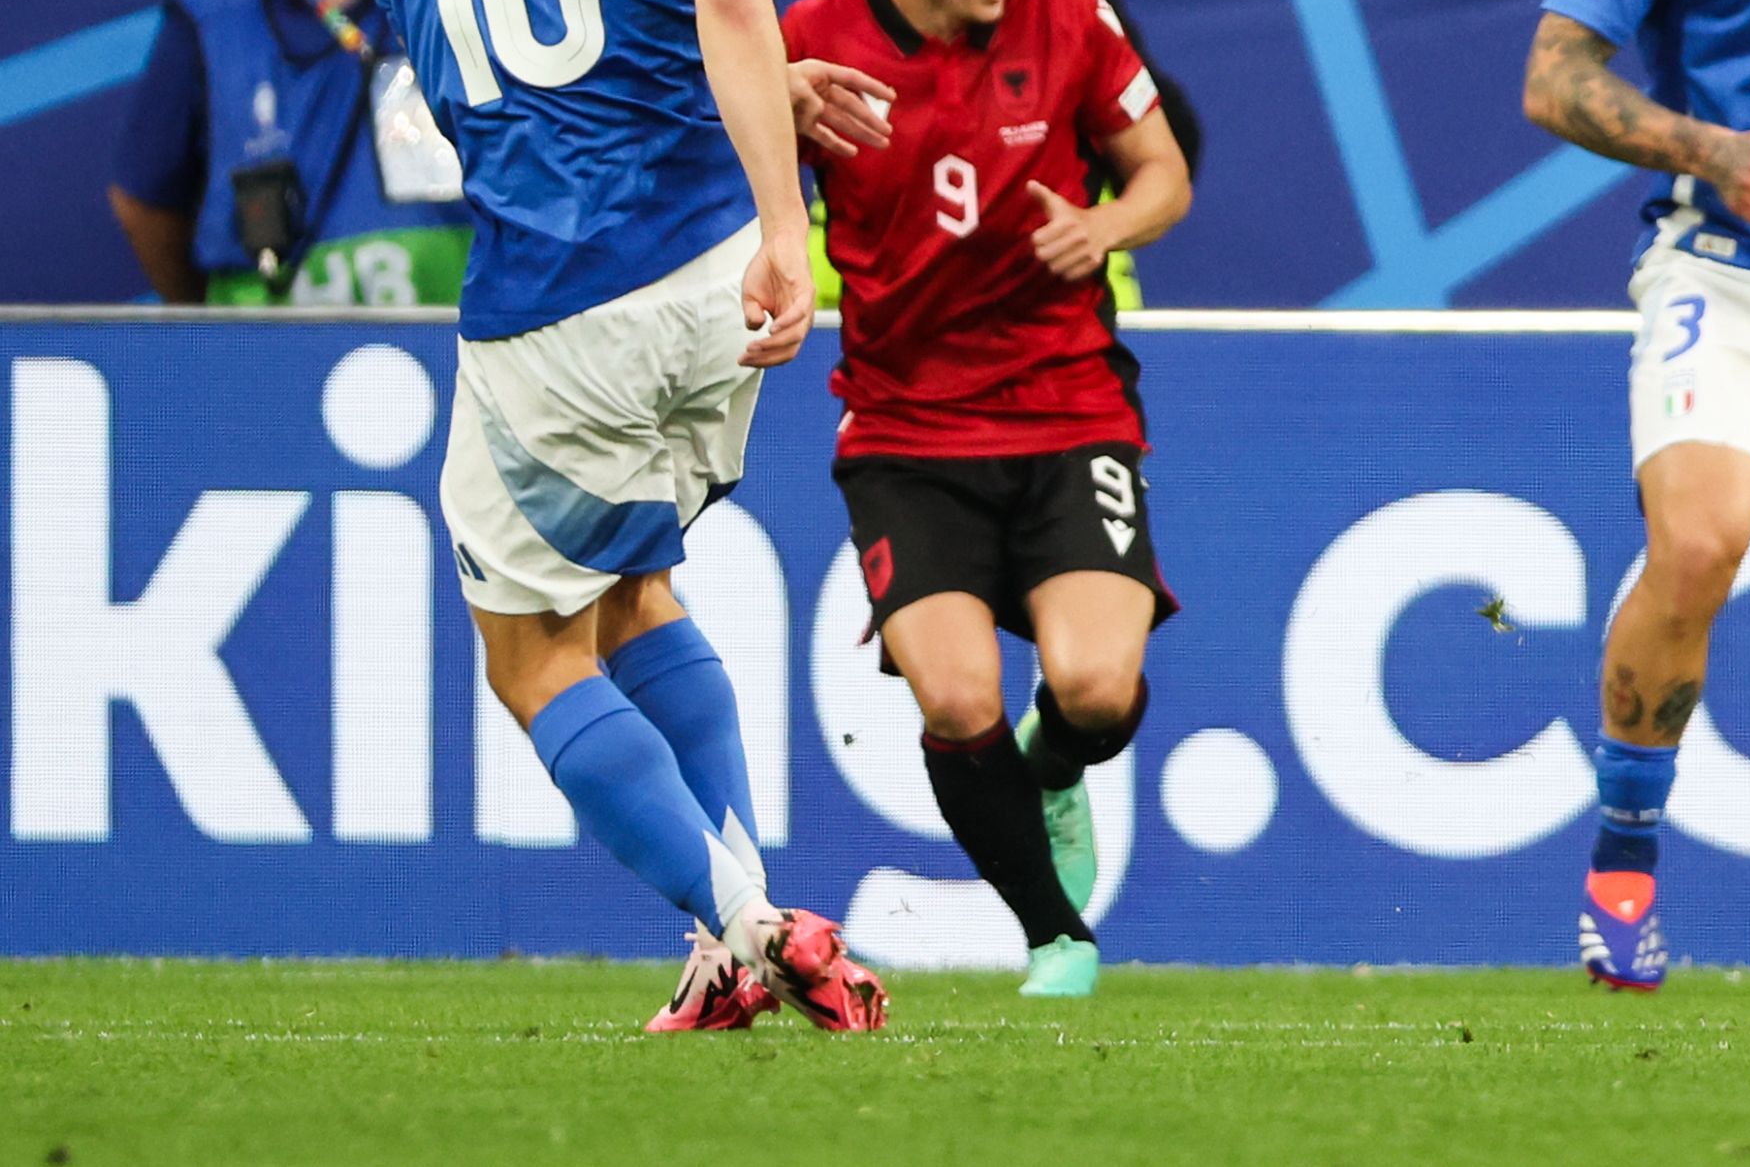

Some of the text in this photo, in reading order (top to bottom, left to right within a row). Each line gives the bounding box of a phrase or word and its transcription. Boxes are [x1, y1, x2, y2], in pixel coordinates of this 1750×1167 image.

[933, 154, 979, 238] 9
[1663, 295, 1706, 362] 3
[1090, 455, 1136, 517] 9
